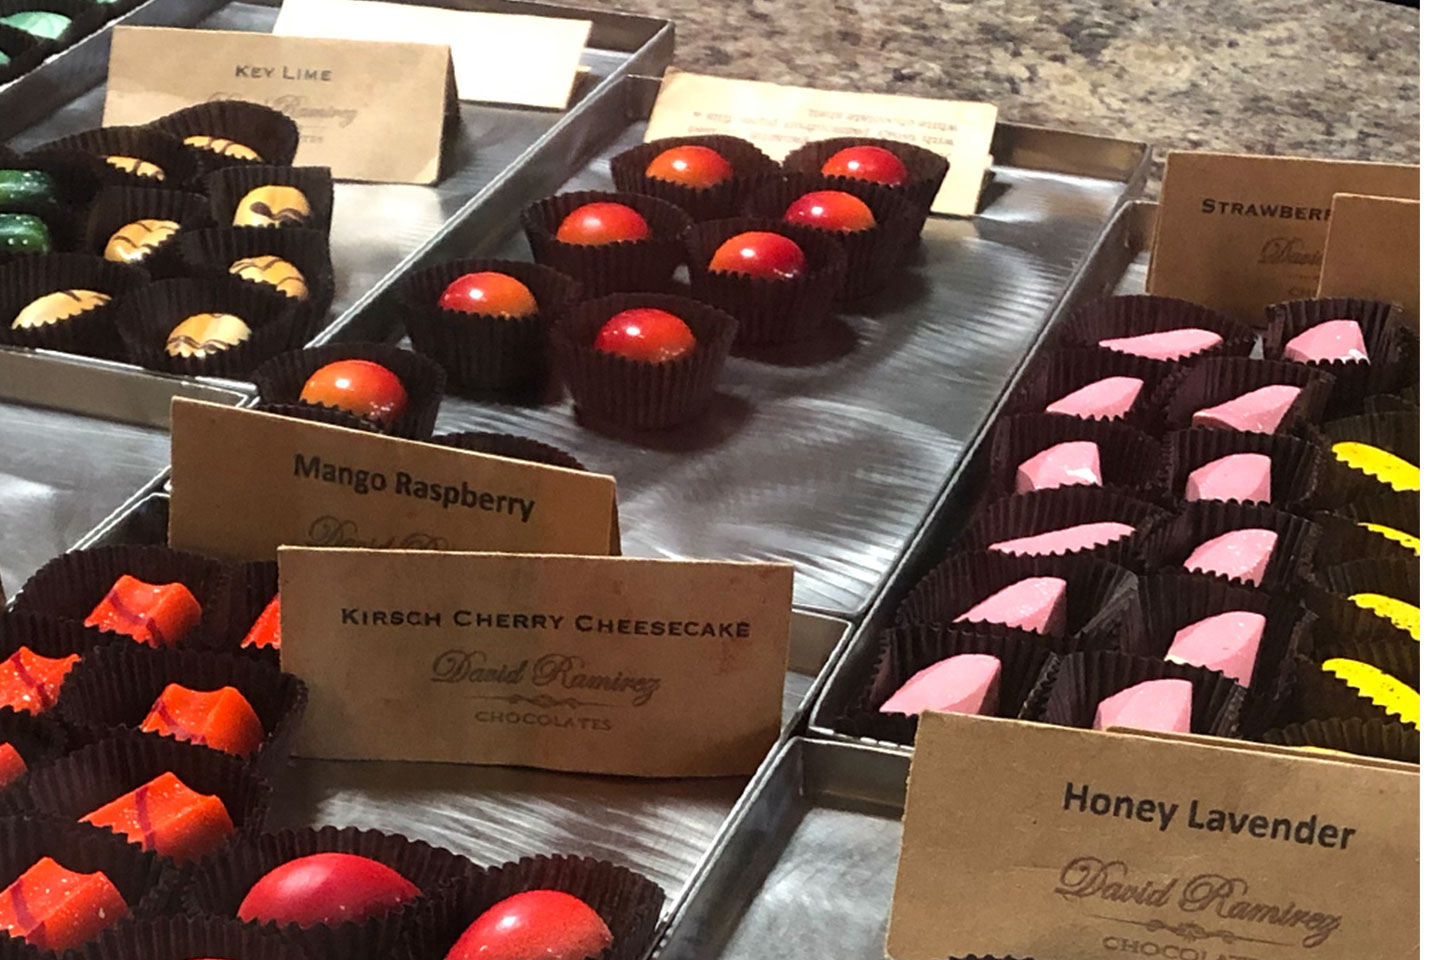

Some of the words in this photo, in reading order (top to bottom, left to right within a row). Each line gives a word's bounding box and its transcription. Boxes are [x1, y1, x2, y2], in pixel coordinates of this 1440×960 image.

[235, 64, 275, 79] KEY
[282, 65, 332, 81] LIME
[293, 453, 387, 494] Mango
[395, 472, 535, 523] Raspberry
[341, 608, 441, 627] KIRSCH
[453, 610, 564, 630] CHERRY
[574, 615, 751, 639] CHEESECAKE
[430, 649, 528, 685] David
[531, 653, 661, 707] Ramirez
[475, 711, 612, 731] CHOCOLATES
[1063, 781, 1179, 832] Honey
[1188, 800, 1357, 850] Lavender
[1054, 856, 1178, 908] David
[1178, 873, 1342, 949] Ramirez
